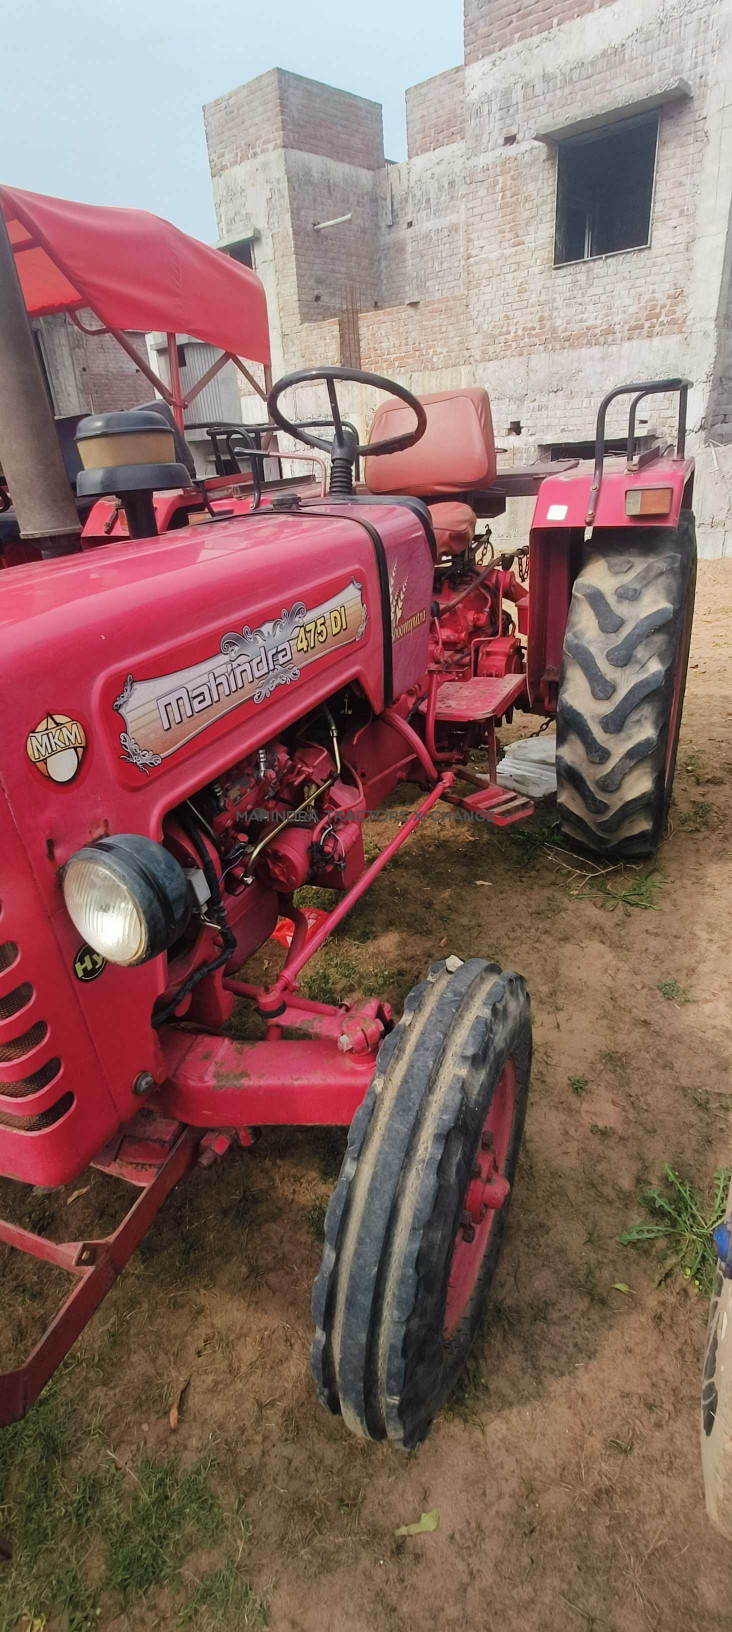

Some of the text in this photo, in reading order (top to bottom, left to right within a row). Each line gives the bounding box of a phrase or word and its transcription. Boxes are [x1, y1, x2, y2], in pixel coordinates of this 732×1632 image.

[157, 605, 348, 731] Mahindra 475 DI
[29, 722, 83, 760] MKM
